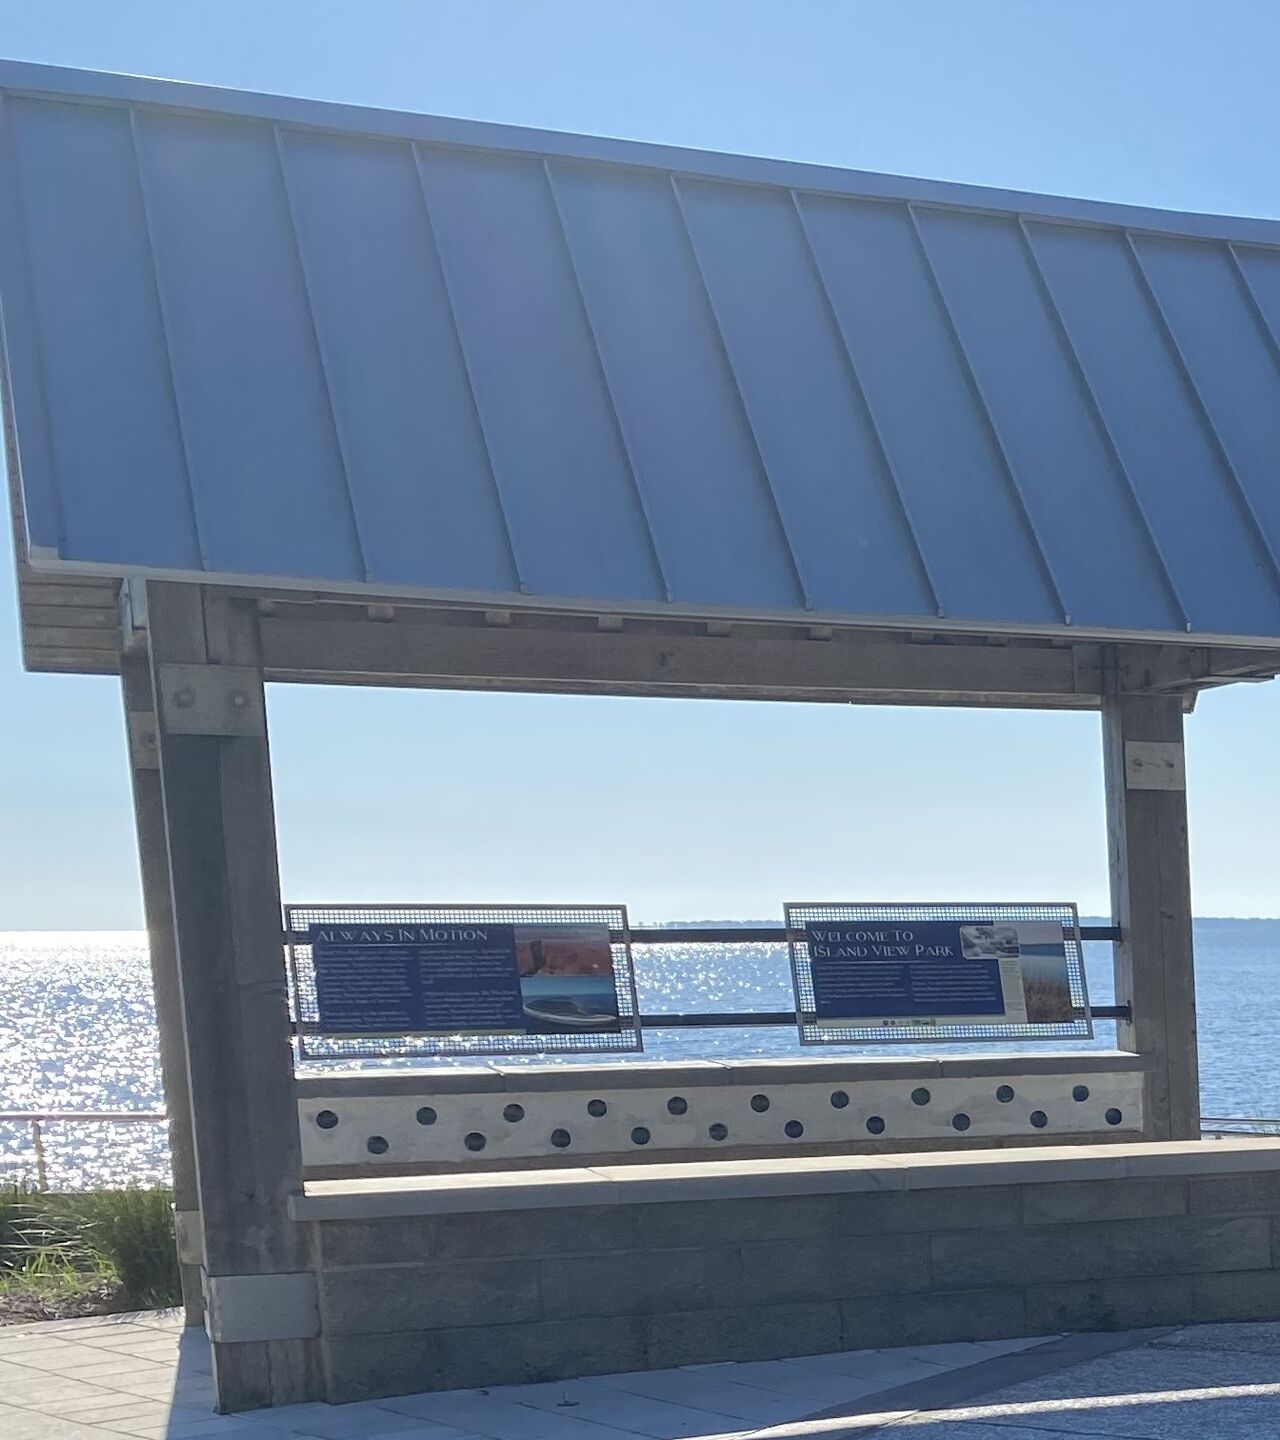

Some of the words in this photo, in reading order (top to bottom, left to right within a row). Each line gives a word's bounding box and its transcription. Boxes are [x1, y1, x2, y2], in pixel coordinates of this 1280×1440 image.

[318, 929, 393, 942] ALWAYS
[420, 928, 488, 941] MOTION
[811, 930, 888, 942] WELCOME
[813, 944, 867, 957] ISLAND
[871, 945, 910, 956] VIEW
[915, 944, 954, 956] PARK
